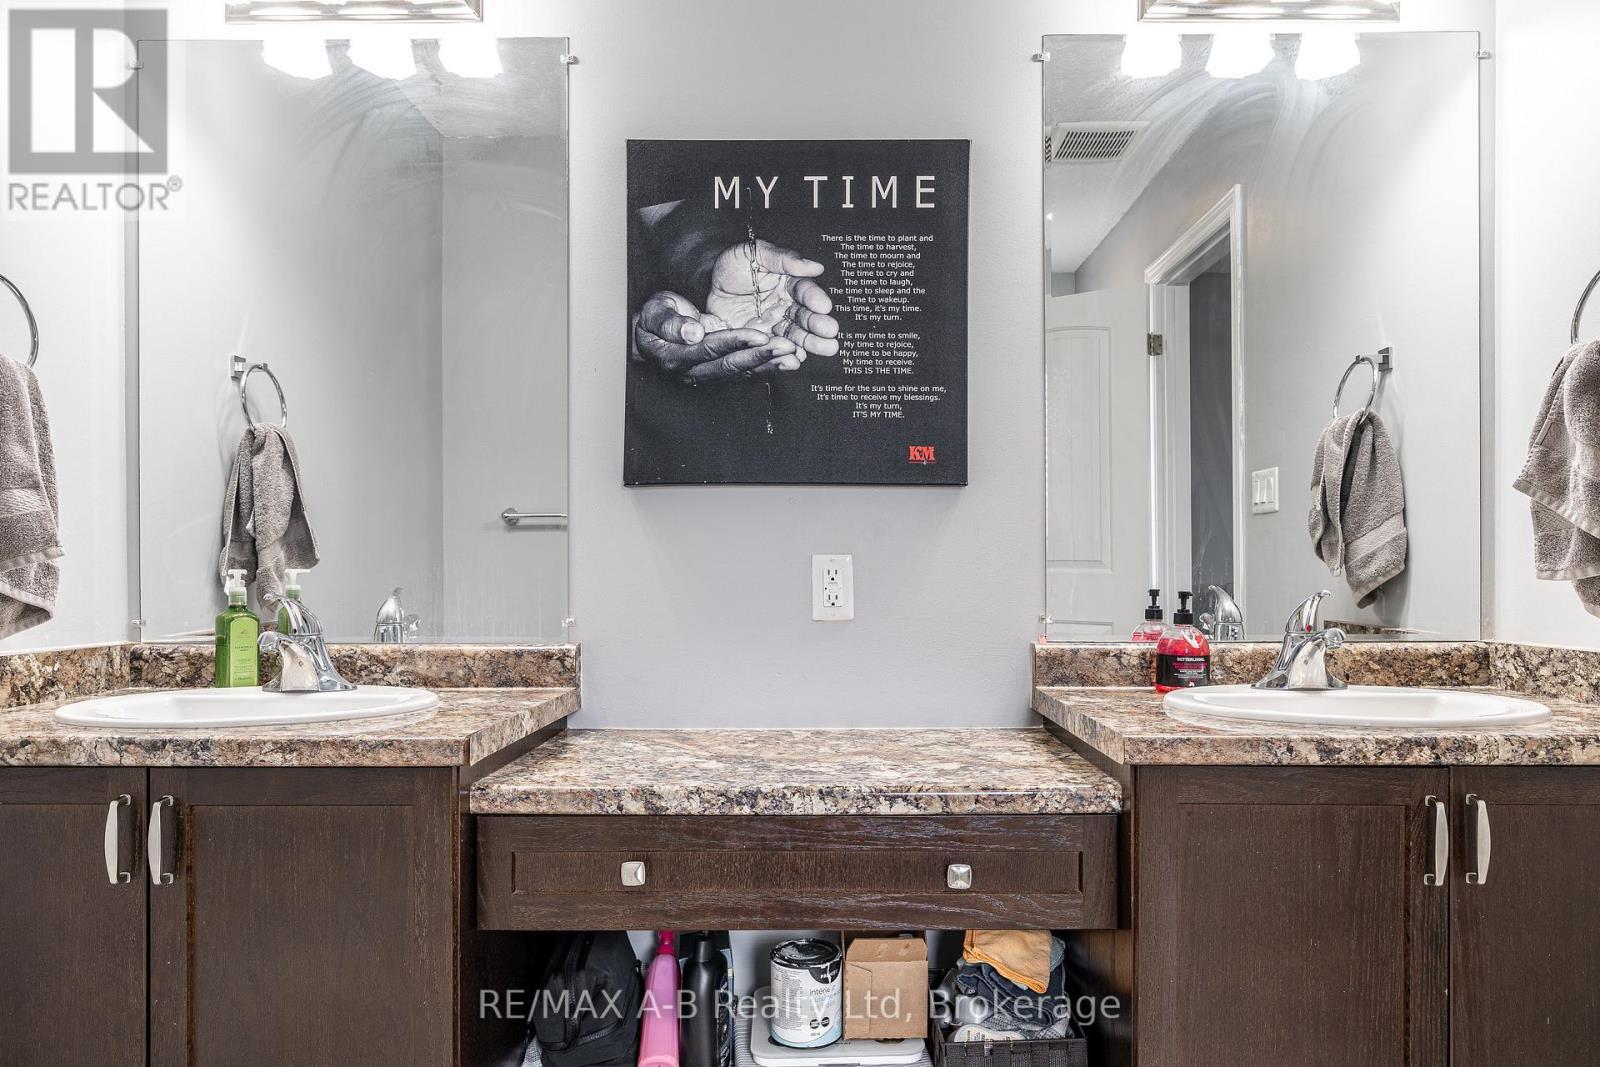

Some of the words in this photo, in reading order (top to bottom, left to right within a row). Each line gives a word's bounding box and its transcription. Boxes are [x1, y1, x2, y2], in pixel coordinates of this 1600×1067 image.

[714, 176, 779, 208] MY
[803, 176, 935, 208] TIME
[898, 234, 916, 243] plant
[886, 243, 916, 252] harvest,
[888, 261, 915, 269] rejoice,
[890, 278, 912, 287] laugh,
[875, 287, 894, 296] sleep
[878, 296, 909, 305] wakeup.
[853, 305, 872, 313] time,
[898, 332, 920, 340] smile,
[844, 341, 854, 349] My
[887, 341, 914, 349] rejoice,
[840, 350, 850, 358] My
[894, 350, 918, 358] happy,
[843, 358, 854, 367] My
[904, 393, 940, 402] blessings.
[884, 402, 902, 411] turn,
